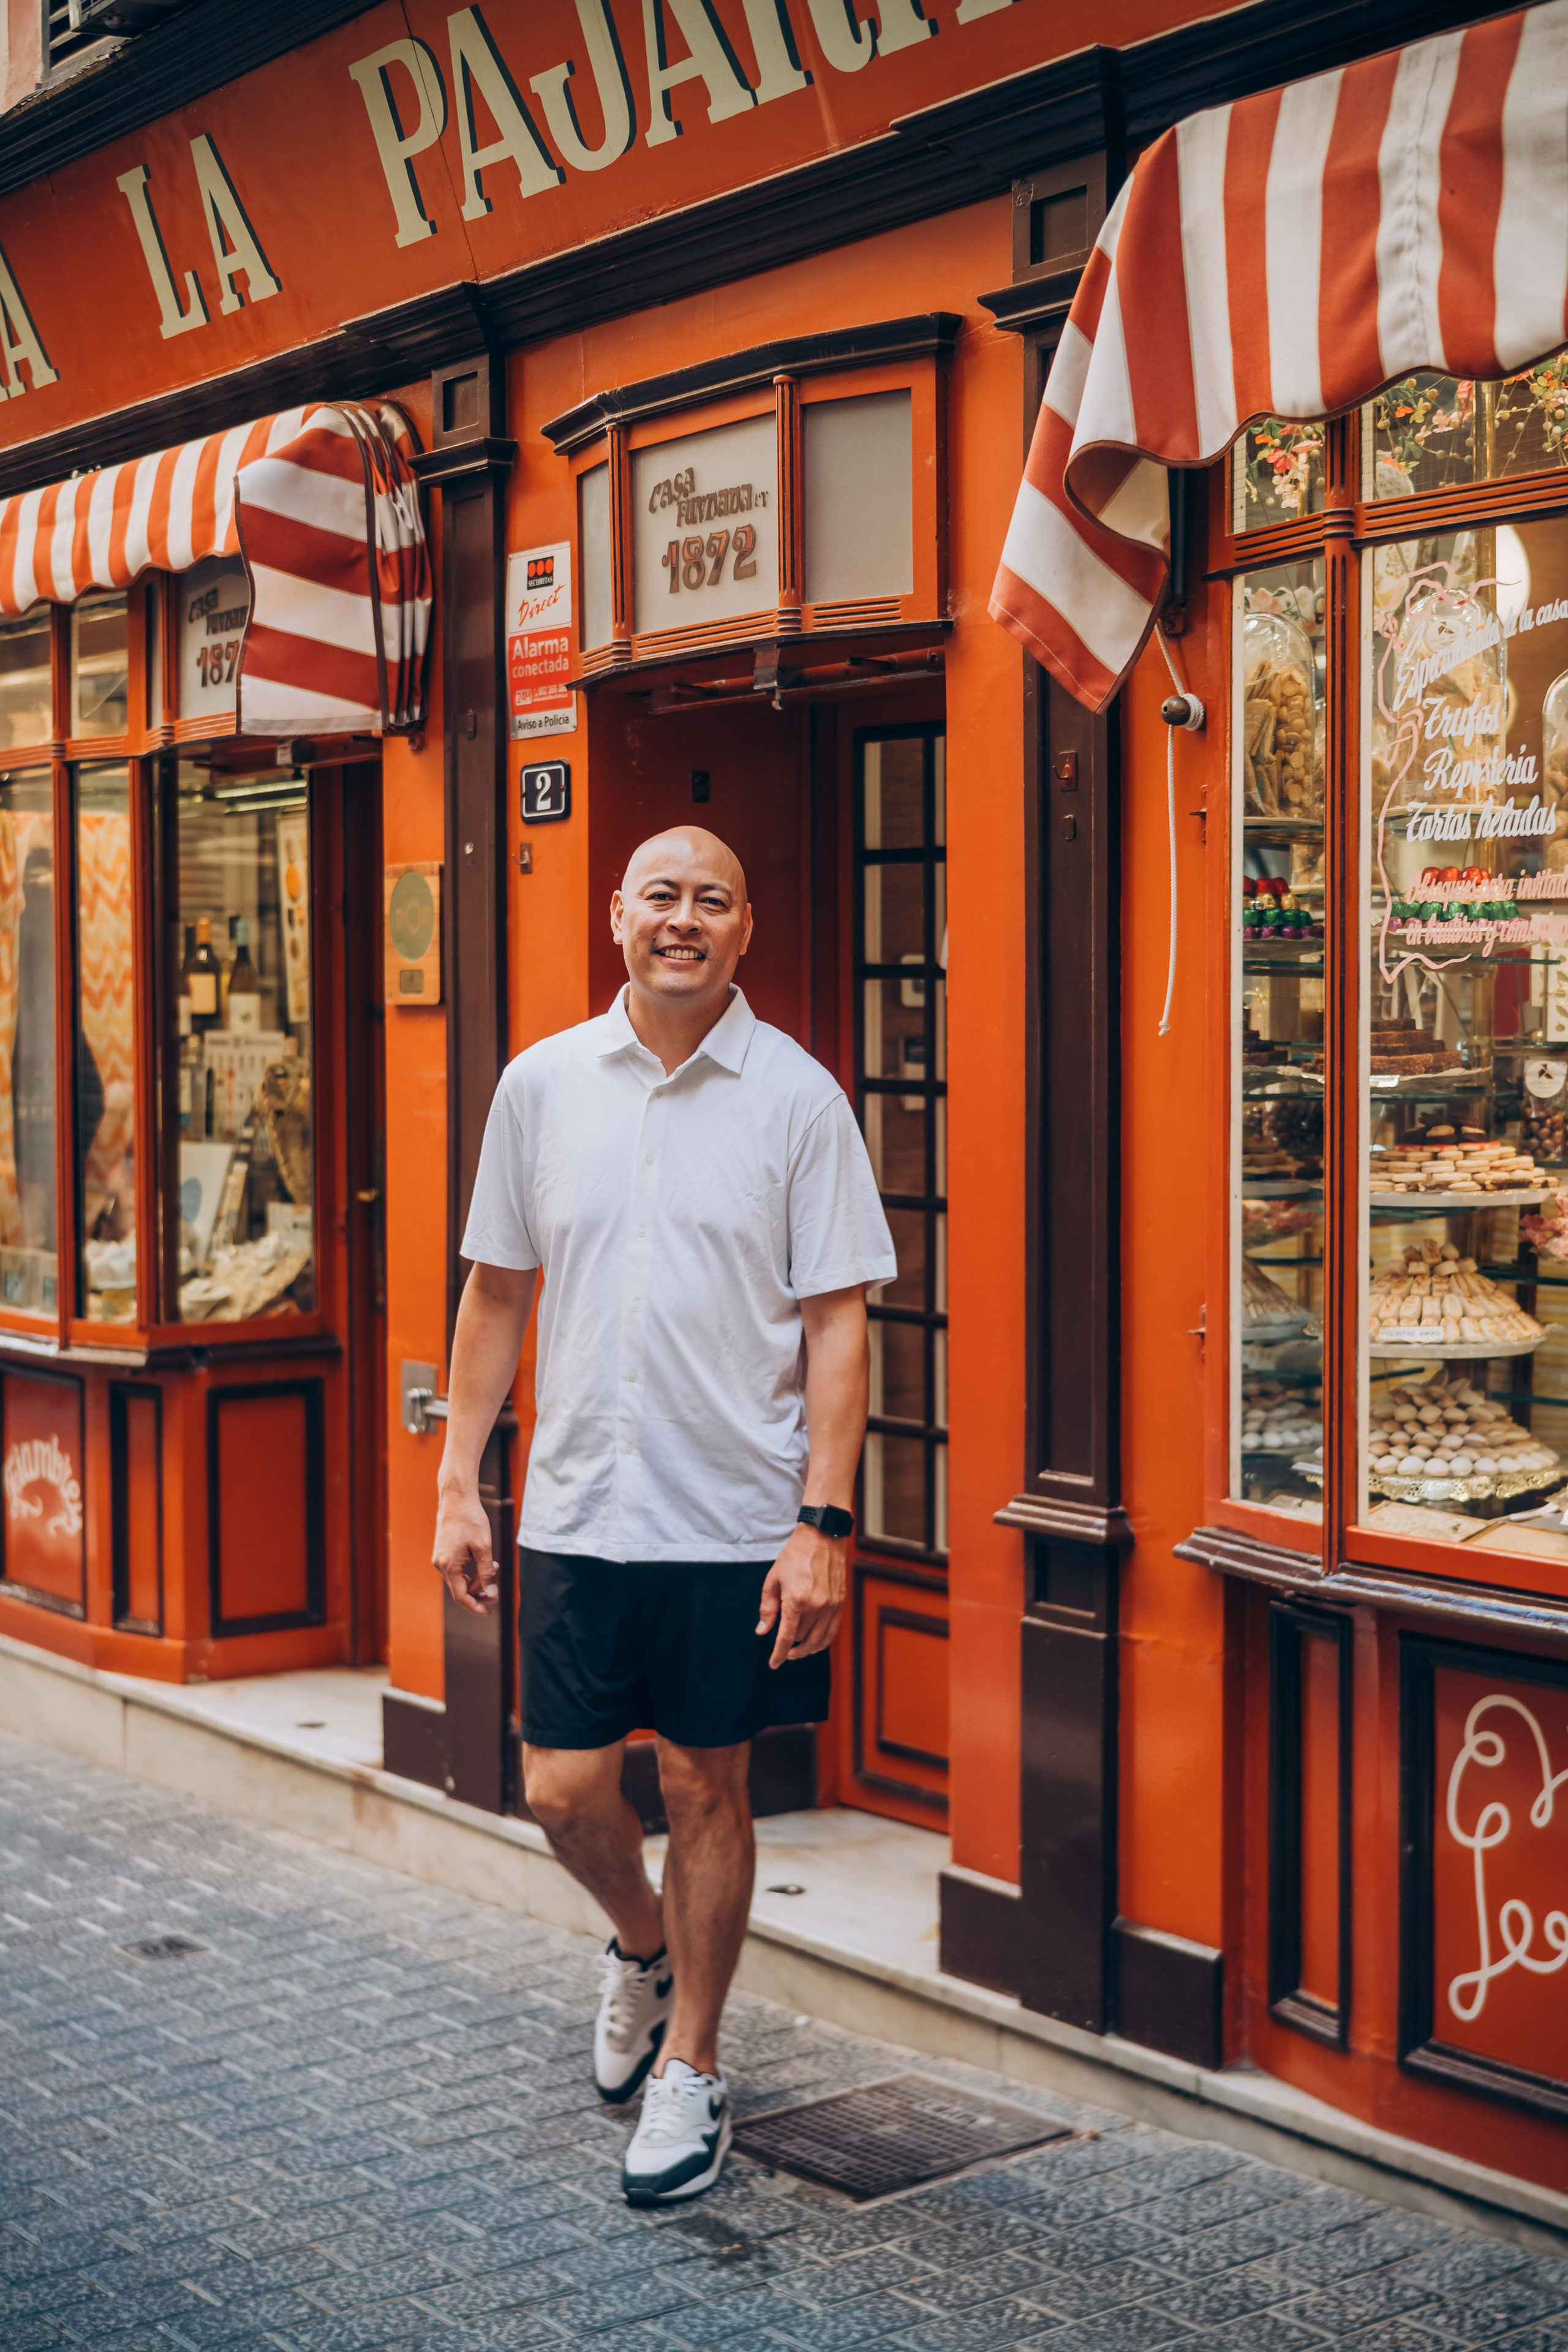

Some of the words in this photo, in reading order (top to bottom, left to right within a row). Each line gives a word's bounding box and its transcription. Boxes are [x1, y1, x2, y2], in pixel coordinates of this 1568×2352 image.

[116, 132, 282, 339] LA
[348, 0, 1022, 249] PAJA
[649, 467, 695, 513] CASA
[676, 483, 752, 527] FUNDADA
[662, 524, 756, 594] 1872
[528, 576, 553, 587] SECURITAS
[518, 584, 567, 627] Direct
[1519, 600, 1534, 633] la
[1536, 598, 1568, 626] casa
[197, 640, 239, 687] 187
[512, 636, 568, 660] Alarma
[512, 657, 570, 679] conectada
[518, 718, 537, 731] Aviso
[538, 720, 543, 728] a
[545, 713, 570, 728] Policía
[1422, 692, 1499, 747] Trufas
[536, 772, 551, 811] 2
[1406, 801, 1472, 842] Tartas
[1474, 794, 1556, 839] heladas
[1476, 873, 1514, 910] para
